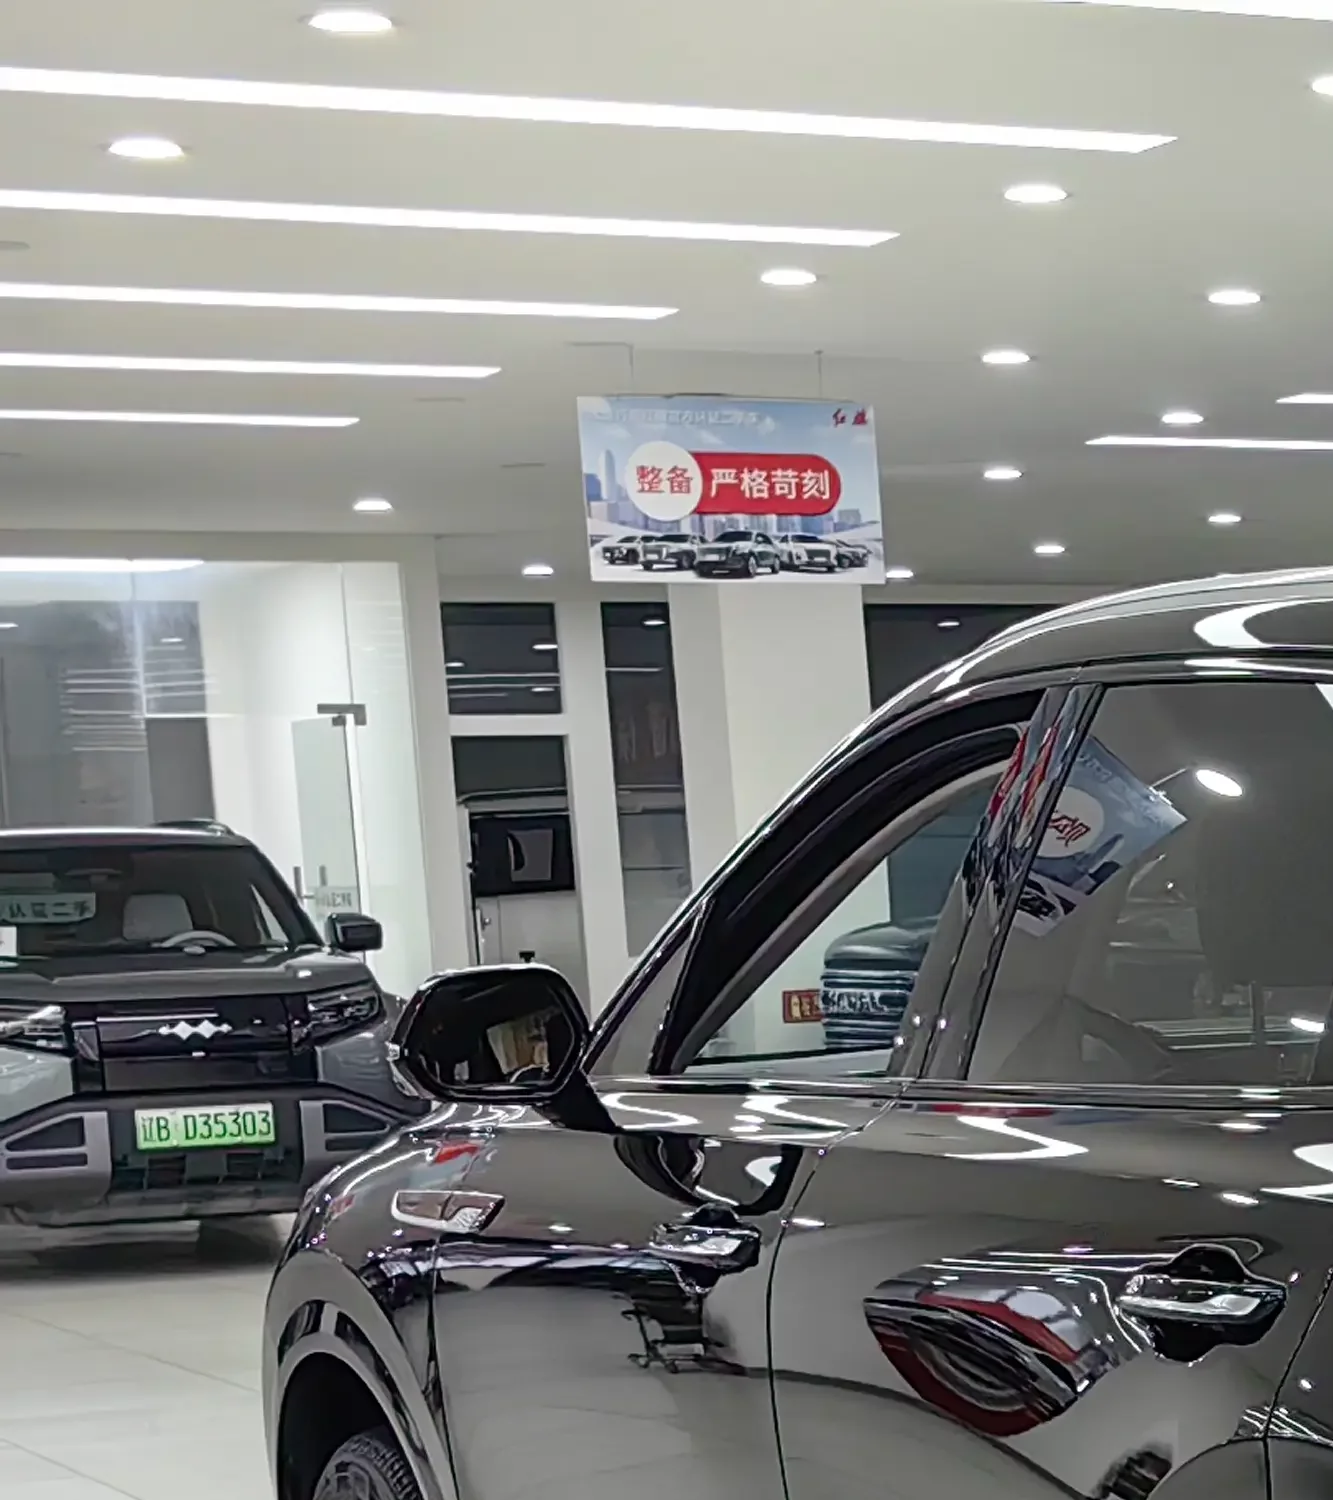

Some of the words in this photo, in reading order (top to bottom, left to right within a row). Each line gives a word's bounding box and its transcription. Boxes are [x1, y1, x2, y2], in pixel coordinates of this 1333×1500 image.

[636, 464, 693, 494] 整备
[710, 468, 831, 499] 严格苛刻
